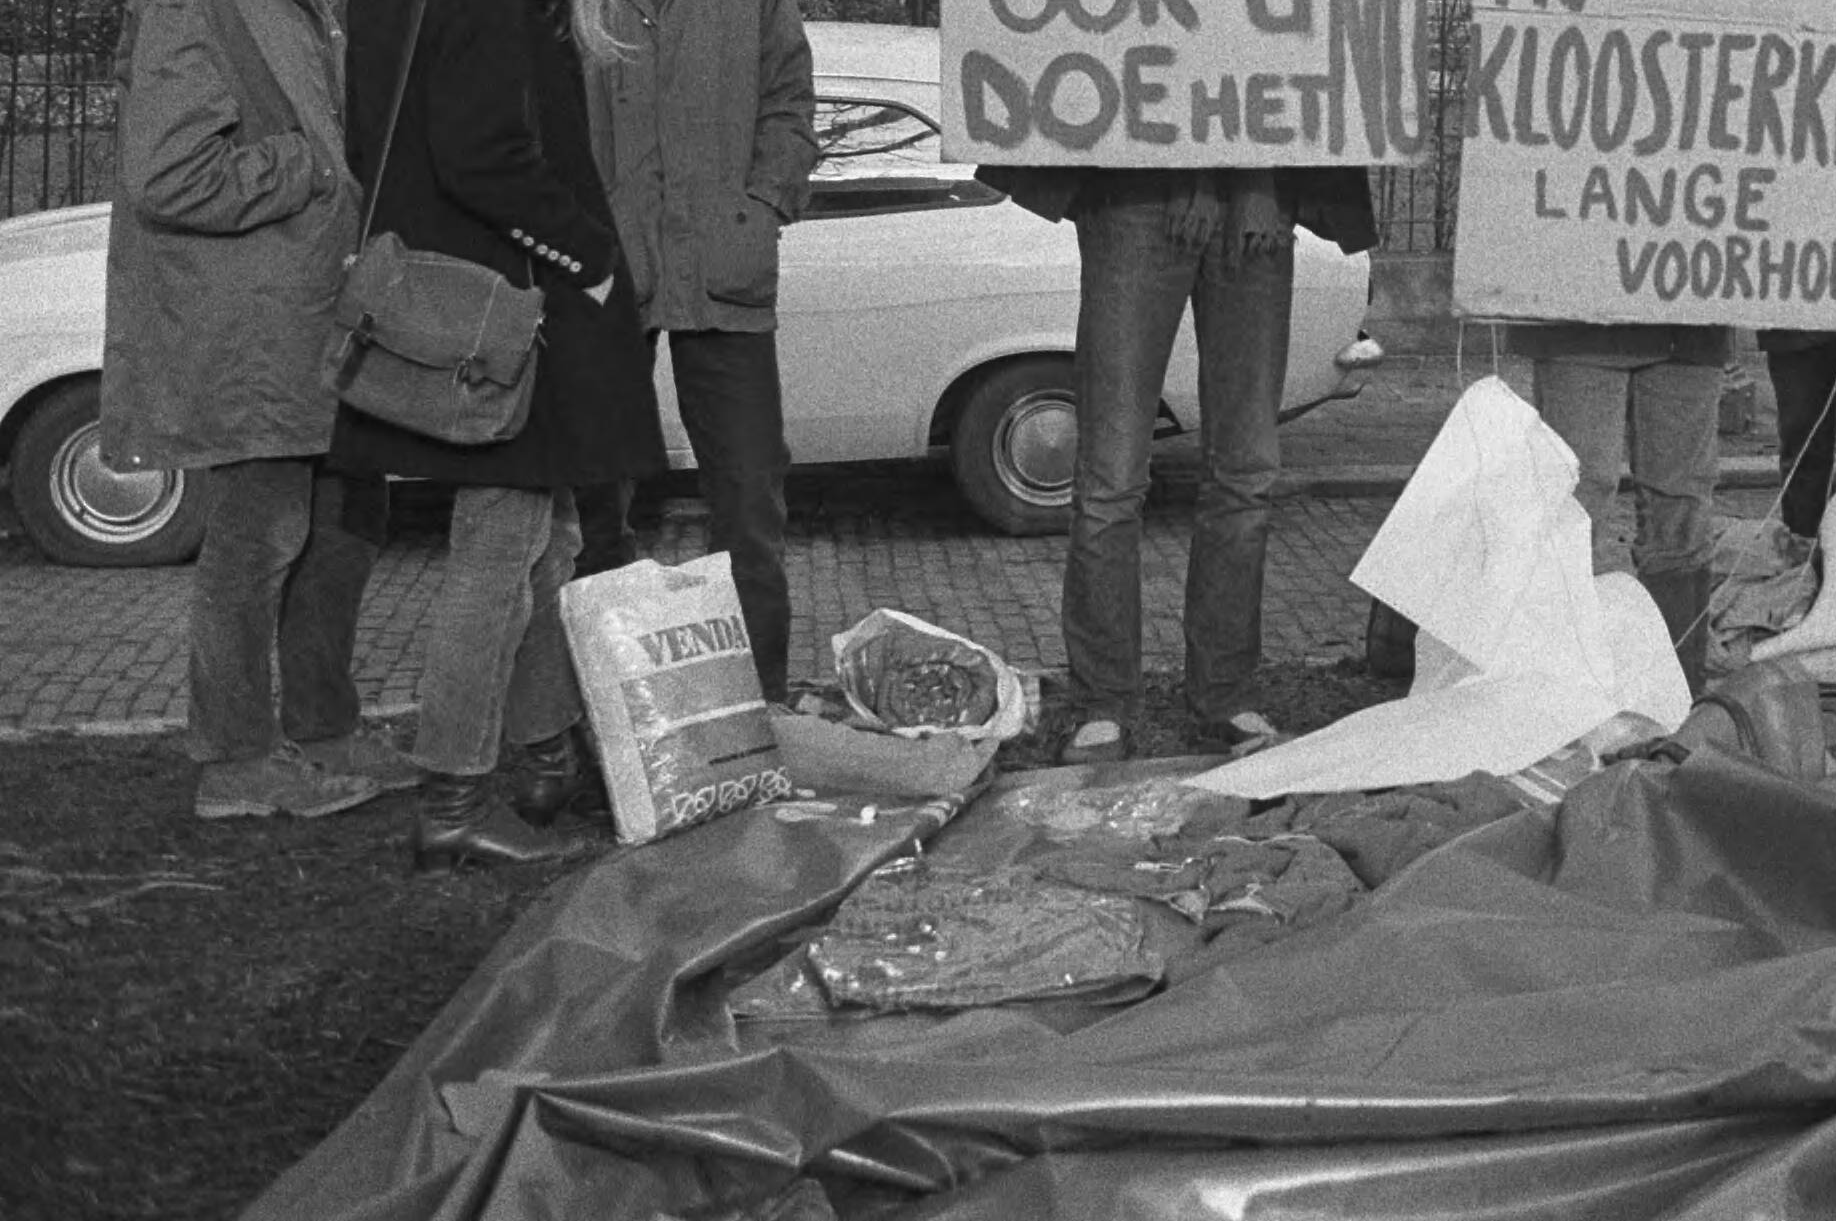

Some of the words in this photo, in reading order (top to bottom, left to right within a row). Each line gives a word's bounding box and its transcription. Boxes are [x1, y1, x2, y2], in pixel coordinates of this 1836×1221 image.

[961, 44, 1180, 151] DOE
[1190, 72, 1329, 144] HET
[1534, 164, 1777, 232] LANGE
